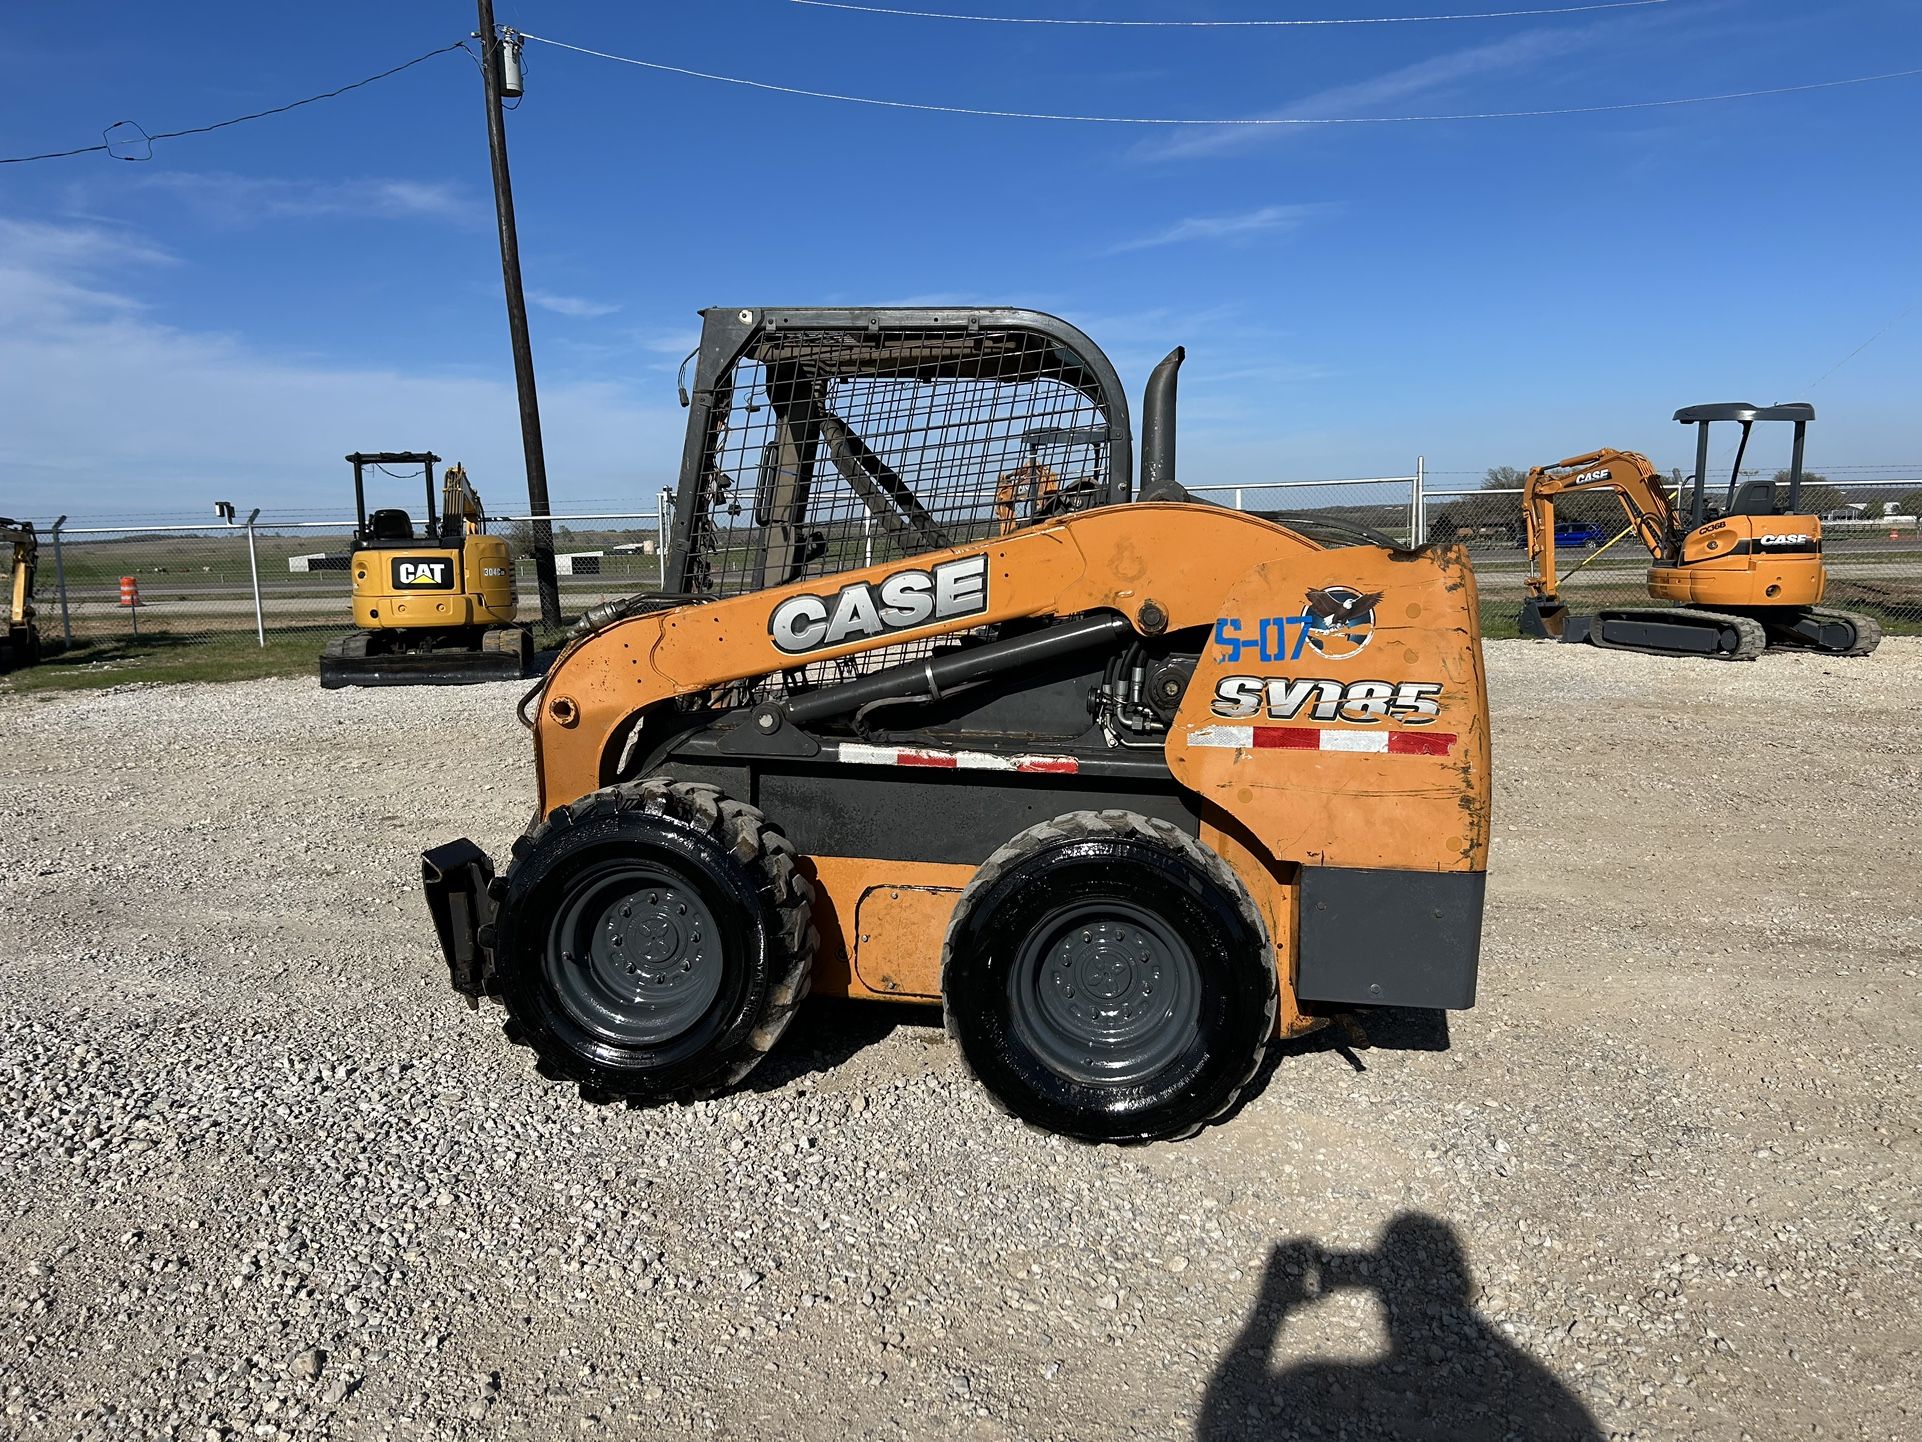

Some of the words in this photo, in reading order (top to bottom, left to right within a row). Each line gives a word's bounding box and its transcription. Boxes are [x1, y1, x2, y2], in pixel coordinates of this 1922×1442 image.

[1576, 469, 1609, 485] CASE
[1699, 521, 1726, 535] CX36B
[1760, 534, 1806, 546] CASE
[400, 563, 445, 584] CAT
[770, 555, 988, 653] CASE
[1213, 616, 1312, 663] S-07
[1211, 675, 1443, 725] SV185
